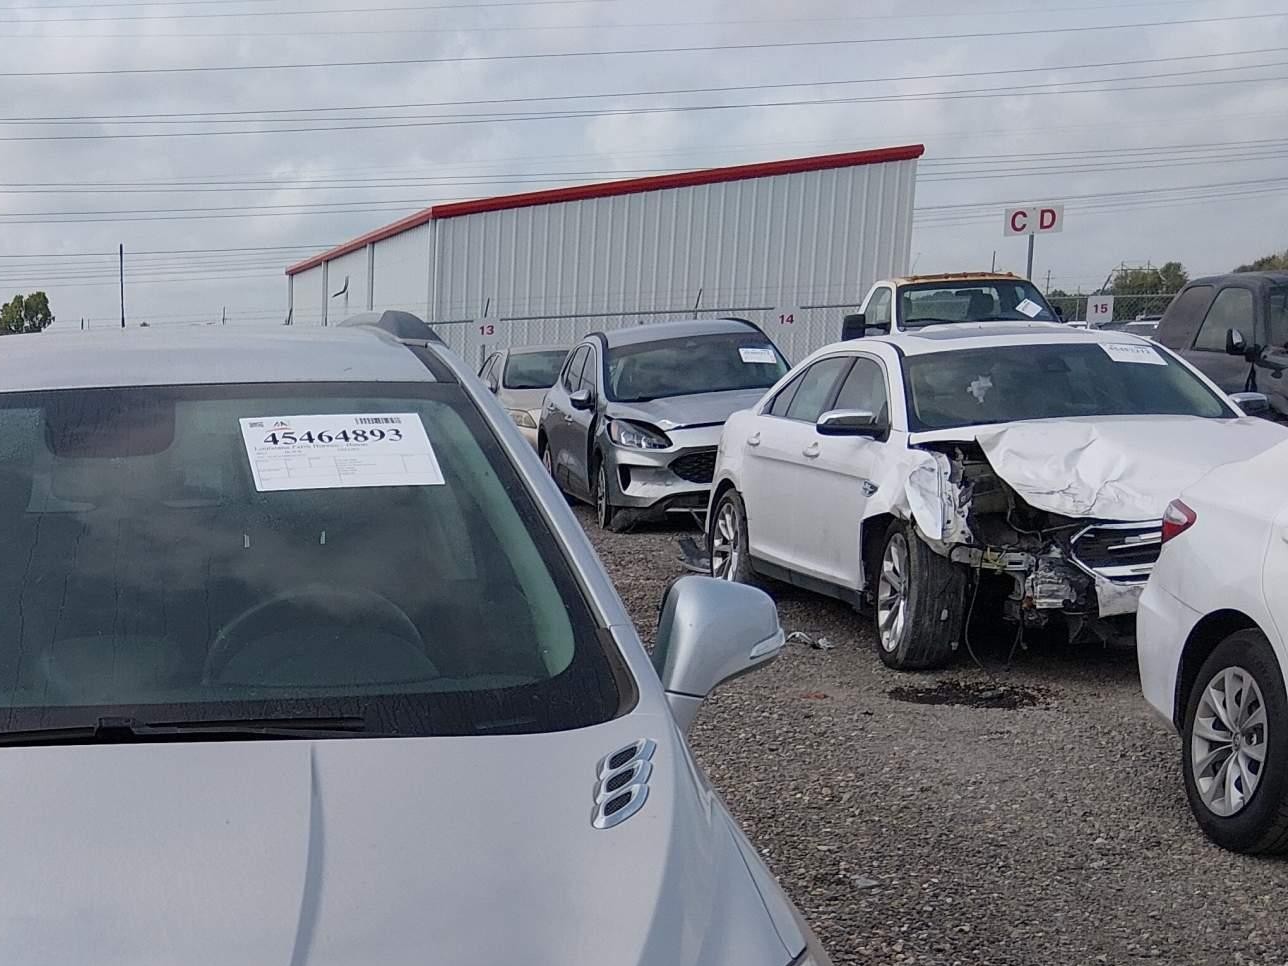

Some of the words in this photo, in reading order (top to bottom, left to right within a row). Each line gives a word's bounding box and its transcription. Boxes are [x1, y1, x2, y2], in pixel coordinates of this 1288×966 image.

[1011, 211, 1028, 232] C
[1039, 209, 1057, 230] D
[1094, 303, 1108, 314] 15
[779, 314, 794, 325] 14
[479, 325, 495, 336] 13
[263, 428, 403, 446] 45464893
